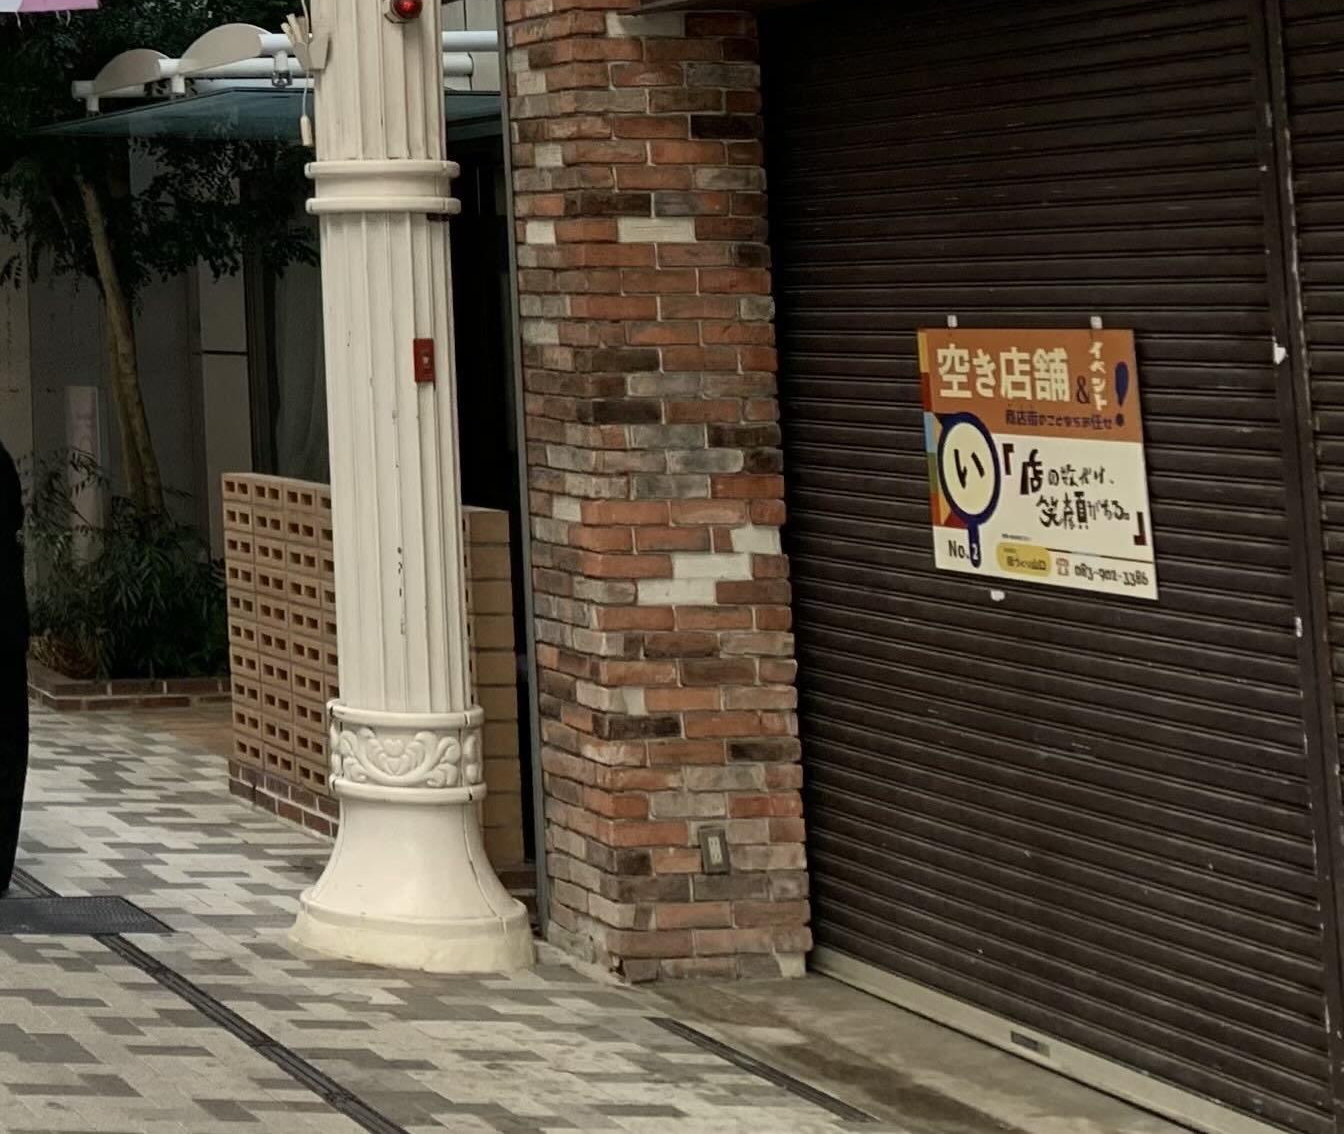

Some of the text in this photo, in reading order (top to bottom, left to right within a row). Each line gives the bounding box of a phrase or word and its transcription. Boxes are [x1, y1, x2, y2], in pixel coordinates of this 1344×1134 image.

[937, 342, 1071, 403] 空き店舗
[1088, 341, 1108, 411] イベント
[953, 448, 985, 489] い
